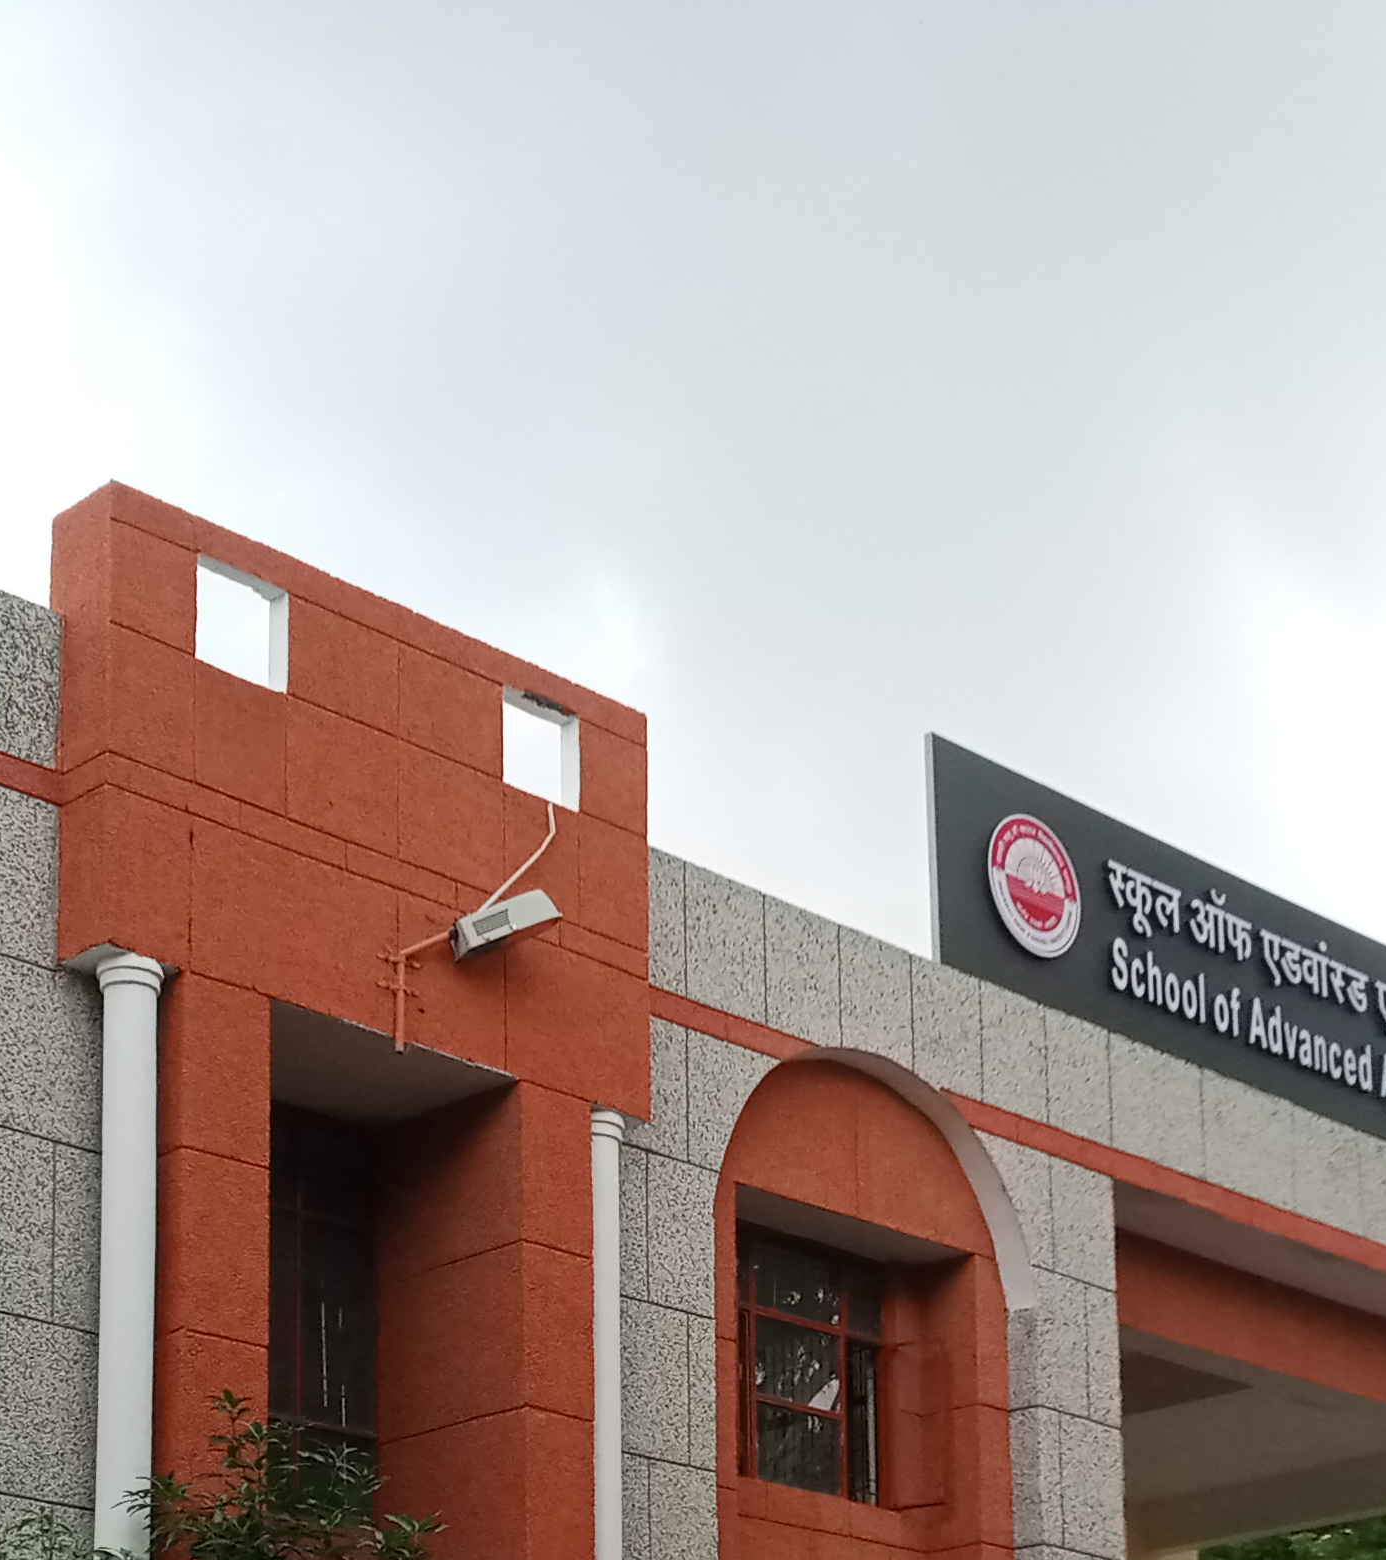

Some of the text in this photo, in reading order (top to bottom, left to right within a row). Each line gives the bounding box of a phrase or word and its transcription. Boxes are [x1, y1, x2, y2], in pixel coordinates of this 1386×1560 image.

[1107, 858, 1182, 938] स्कूल
[1189, 888, 1253, 961] ऑफ
[1260, 928, 1369, 1013] एडवांस्ड
[1111, 936, 1207, 1024] School
[1214, 986, 1241, 1038] of
[1248, 997, 1374, 1093] Advanced
